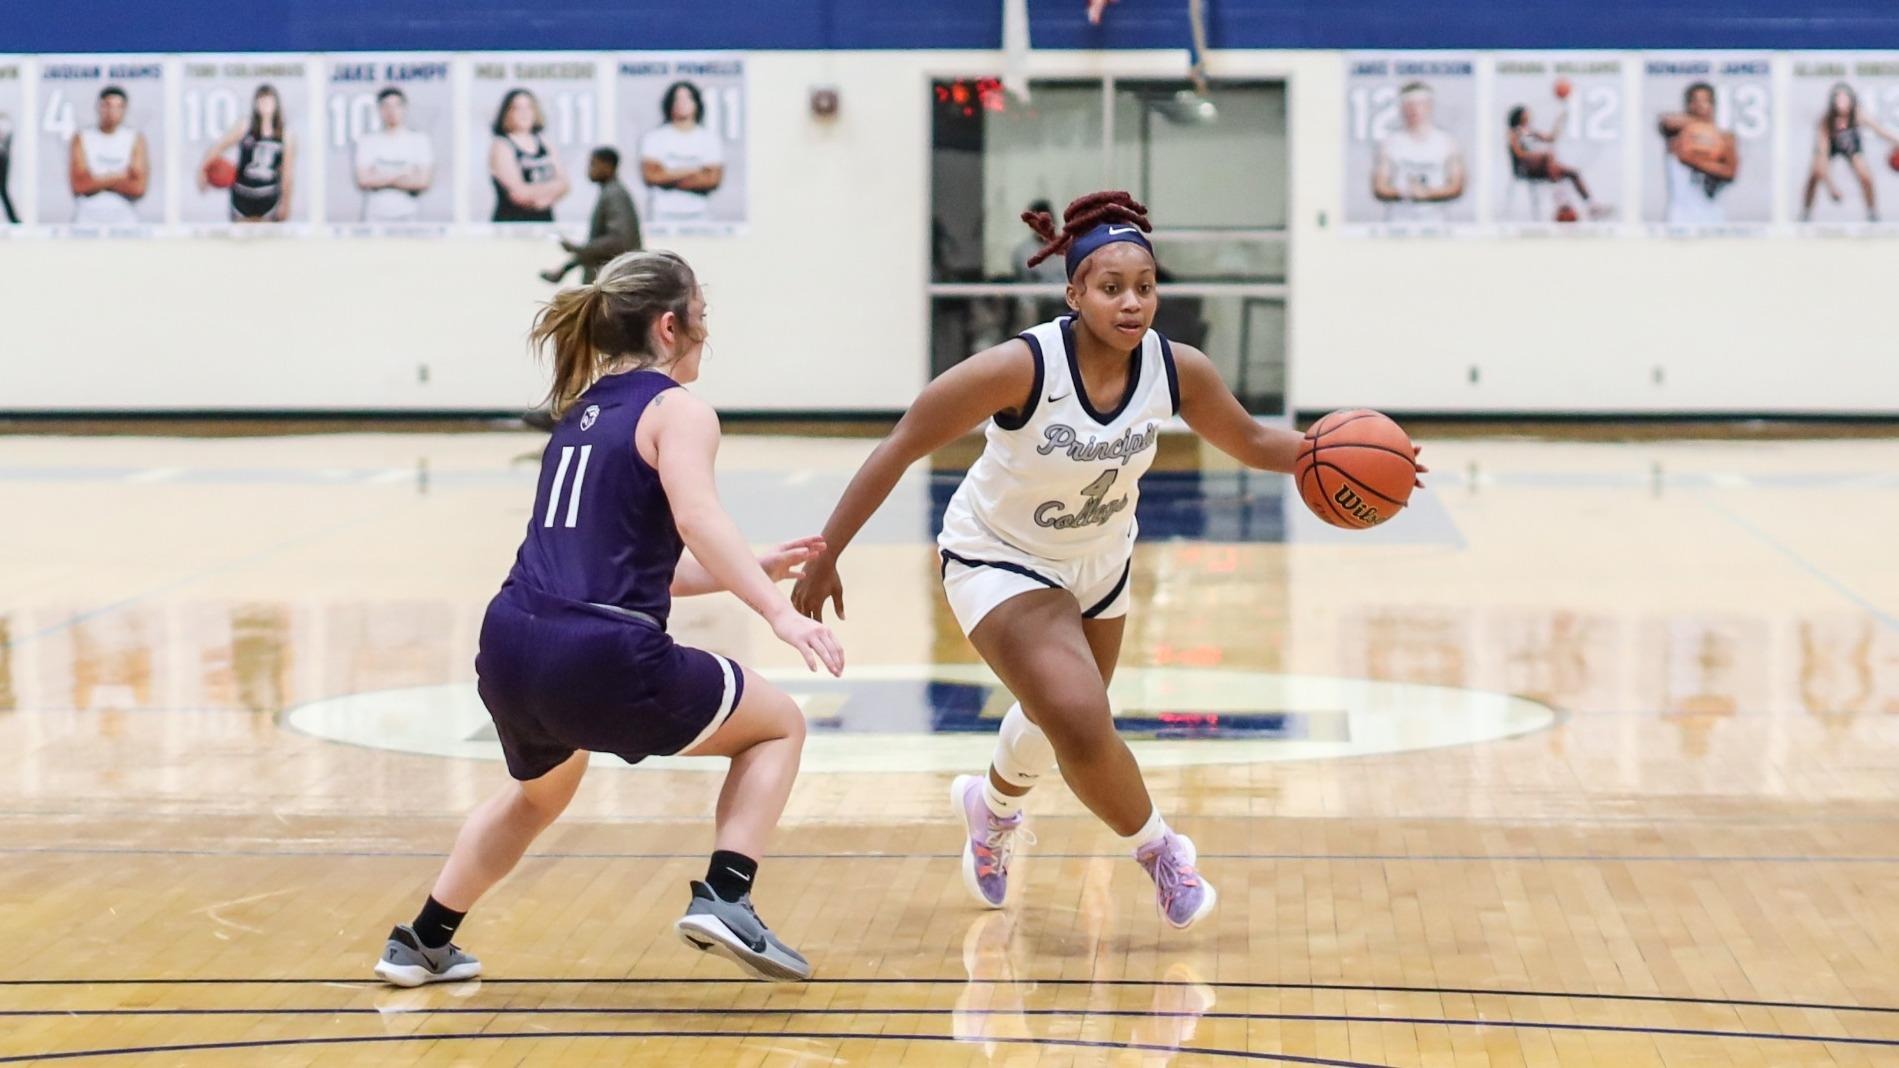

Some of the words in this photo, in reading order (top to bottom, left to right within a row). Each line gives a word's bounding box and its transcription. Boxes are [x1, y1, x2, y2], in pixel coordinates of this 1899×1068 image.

[43, 88, 76, 141] 4
[182, 88, 241, 141] 10
[557, 90, 597, 146] 11
[1568, 84, 1621, 140] 12
[543, 444, 592, 528] 11
[1080, 468, 1119, 503] 4
